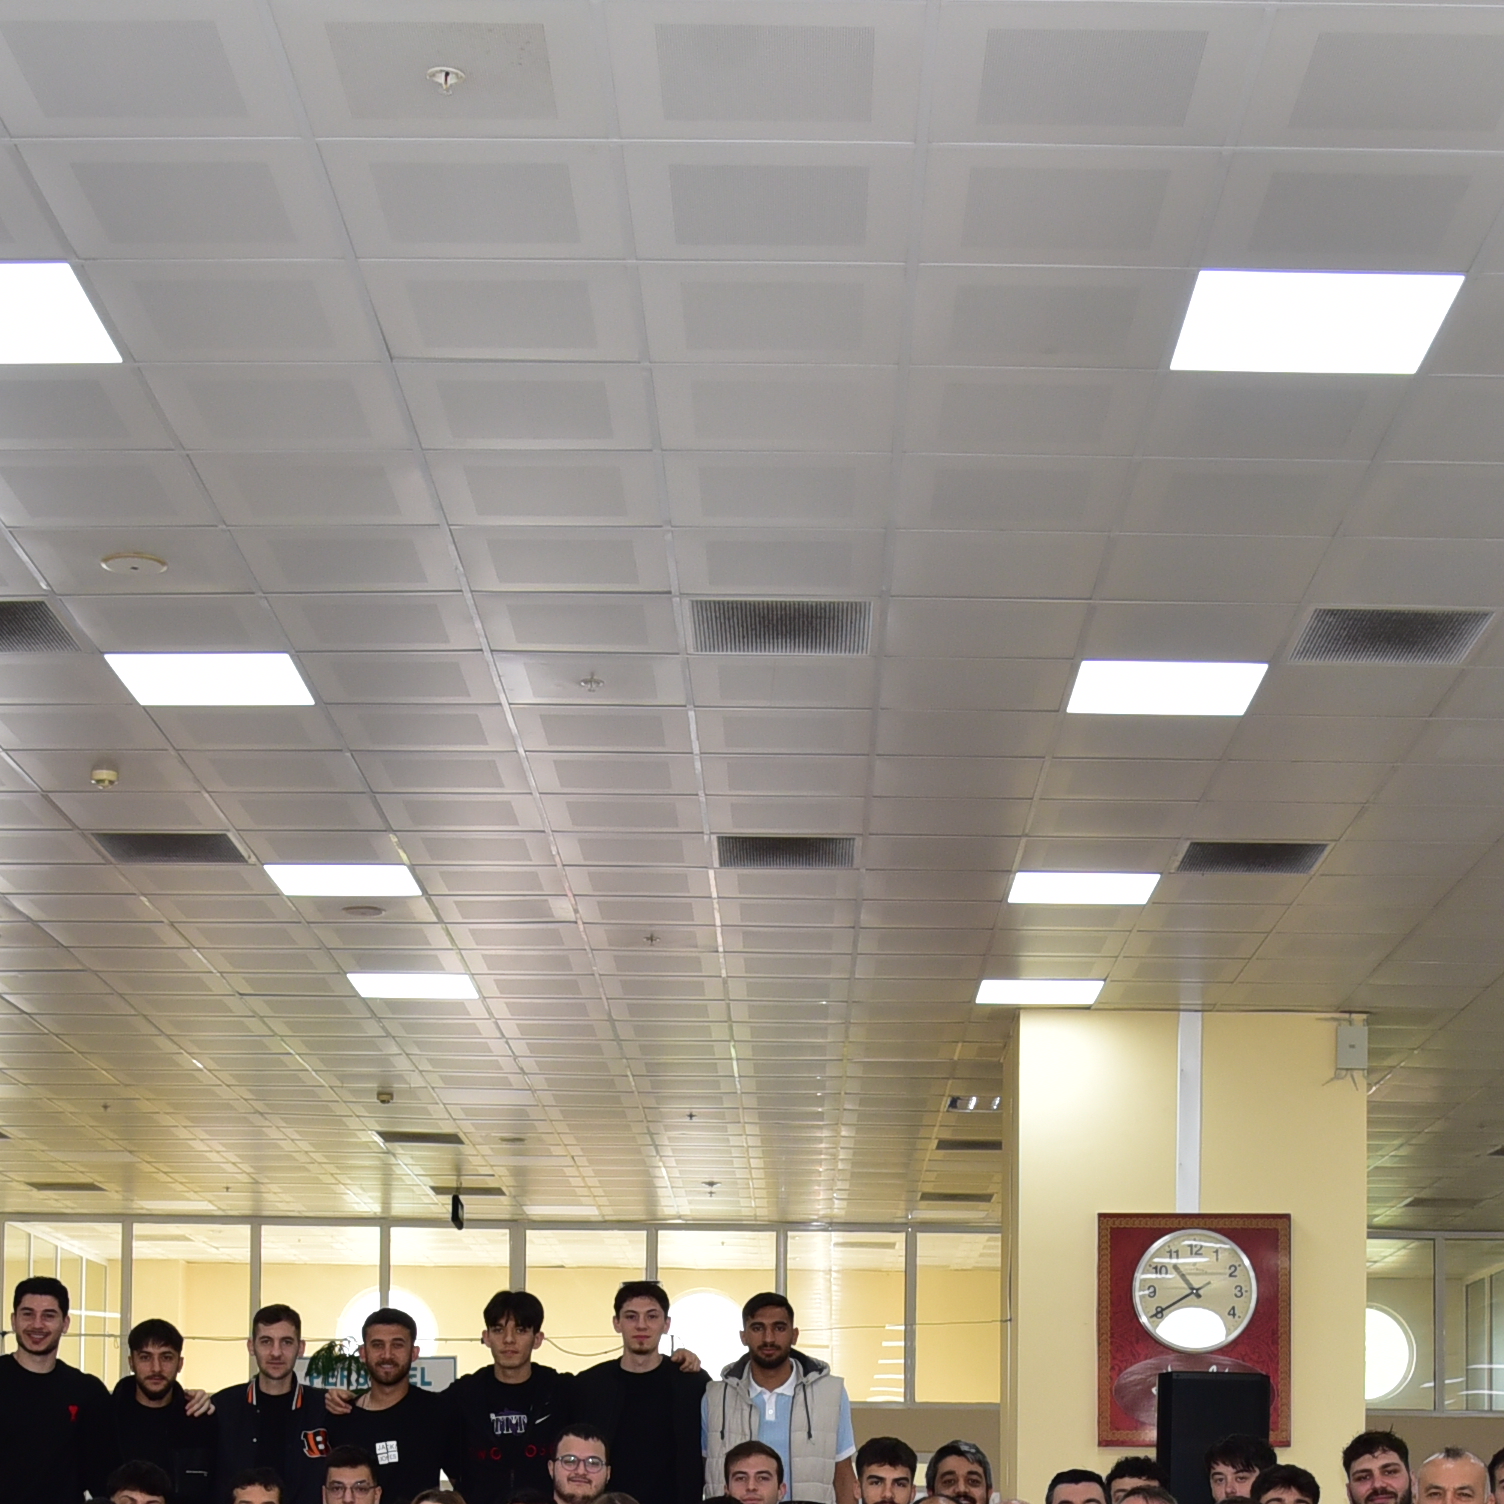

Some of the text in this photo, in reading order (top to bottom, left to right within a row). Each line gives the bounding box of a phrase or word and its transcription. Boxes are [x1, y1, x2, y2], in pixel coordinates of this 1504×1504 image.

[1166, 1249, 1180, 1260] 11
[1187, 1244, 1203, 1256] 12
[1212, 1249, 1219, 1262] 1
[1152, 1265, 1168, 1275] 10
[1228, 1264, 1238, 1278] 2
[1147, 1285, 1156, 1298] 9
[1234, 1285, 1243, 1298] 3
[1155, 1306, 1164, 1319] 8
[1227, 1306, 1236, 1319] 4
[308, 1366, 433, 1387] PERSEL
